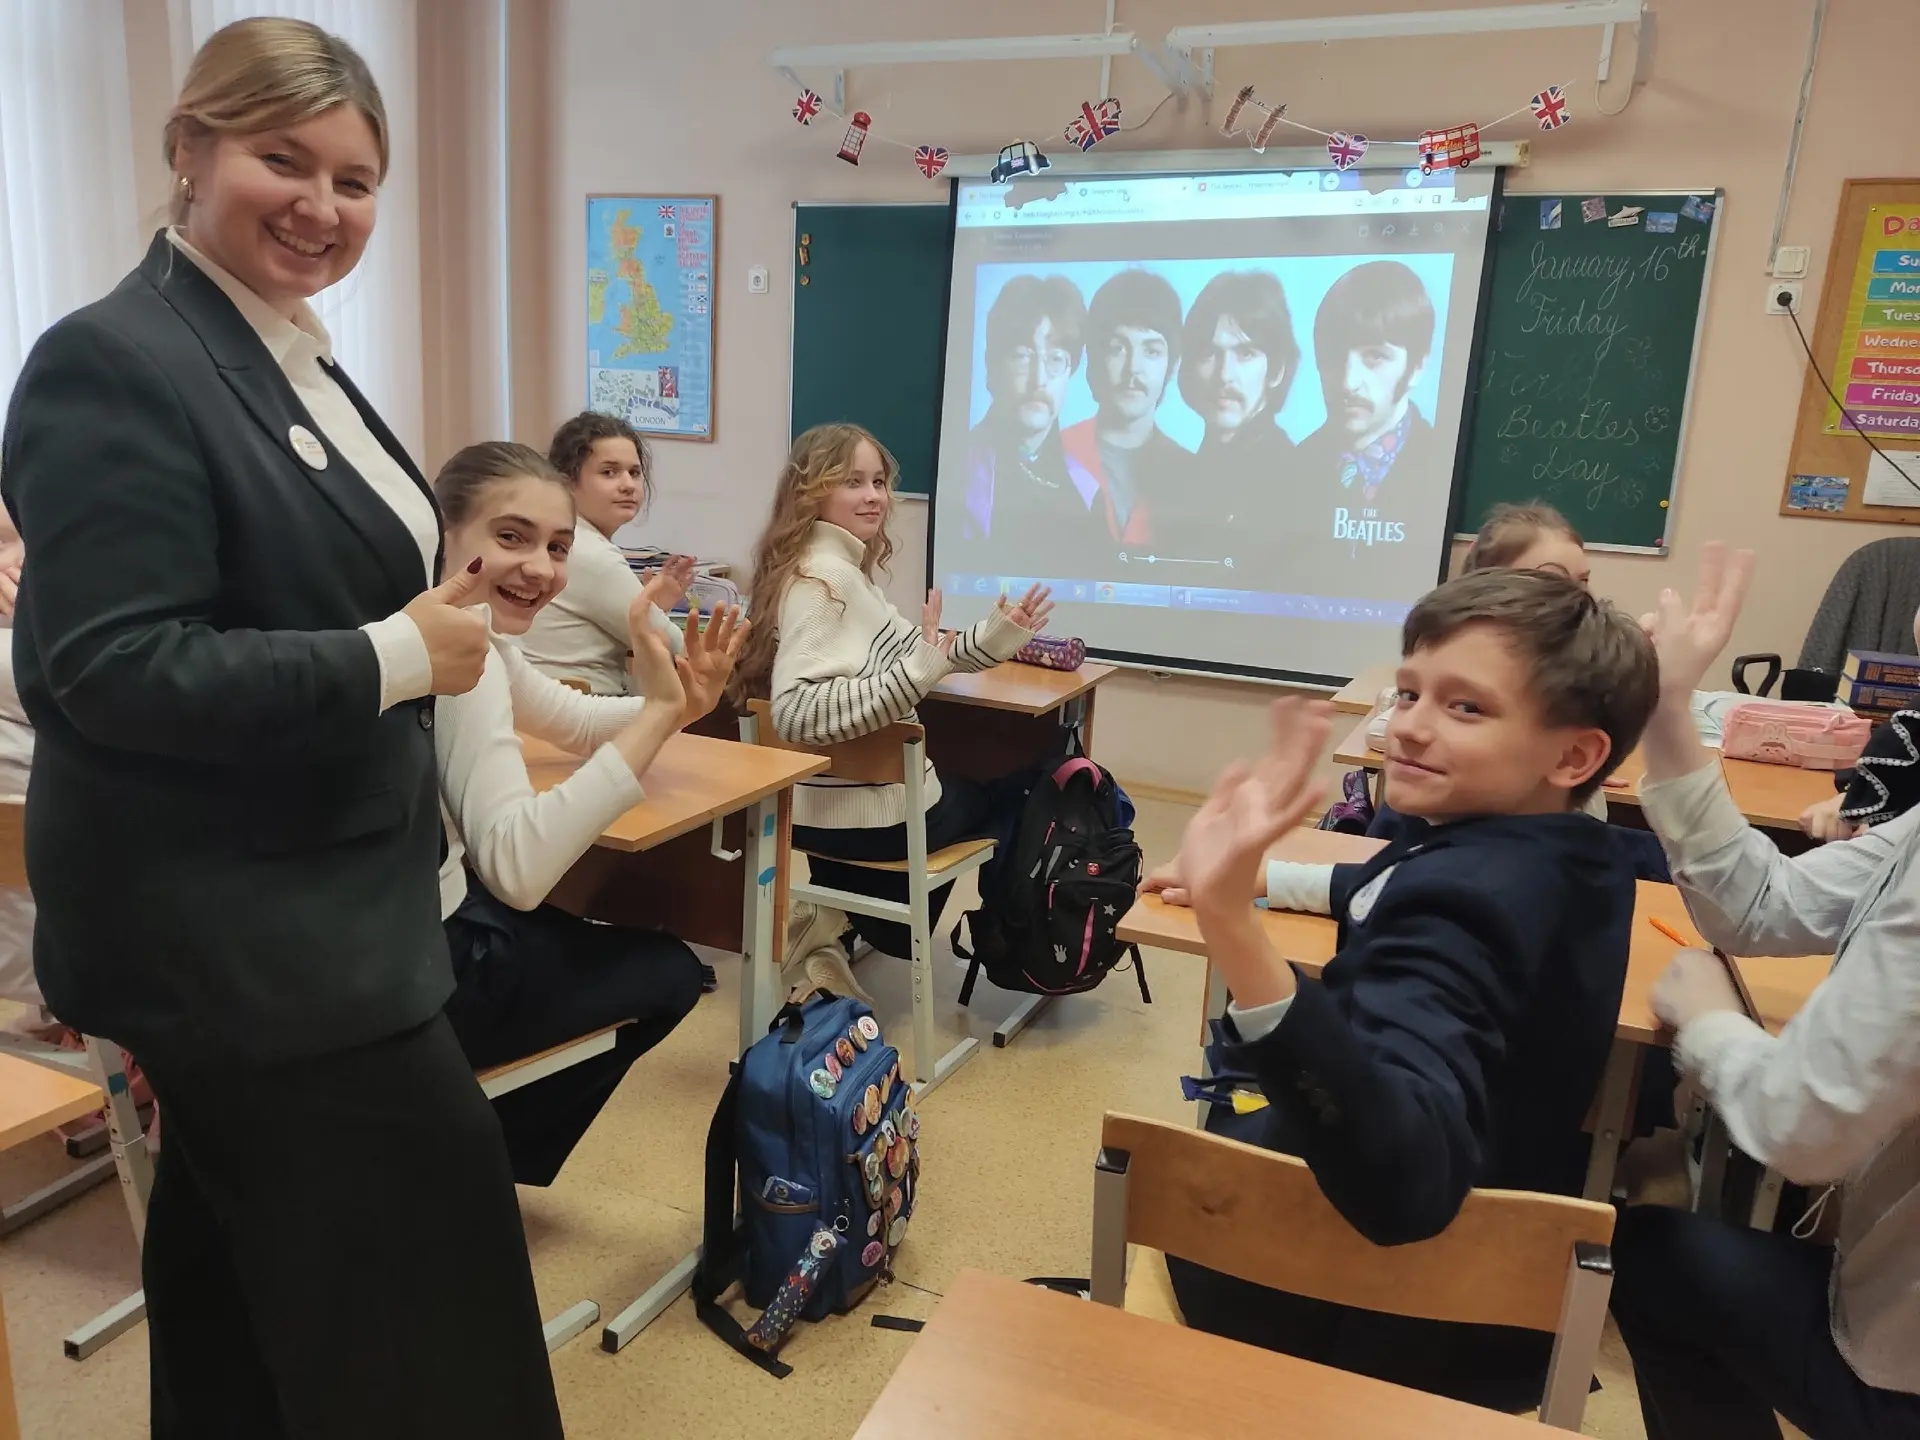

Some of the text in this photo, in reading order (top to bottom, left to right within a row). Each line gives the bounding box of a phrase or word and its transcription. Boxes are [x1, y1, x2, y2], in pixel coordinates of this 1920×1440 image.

[1898, 254, 1920, 267] Su
[1520, 292, 1628, 361] Friday
[1864, 334, 1920, 348] Wedne
[635, 415, 667, 426] LONDON
[1497, 401, 1640, 446] Beatles
[1532, 446, 1620, 511] Day
[1363, 507, 1378, 518] THE
